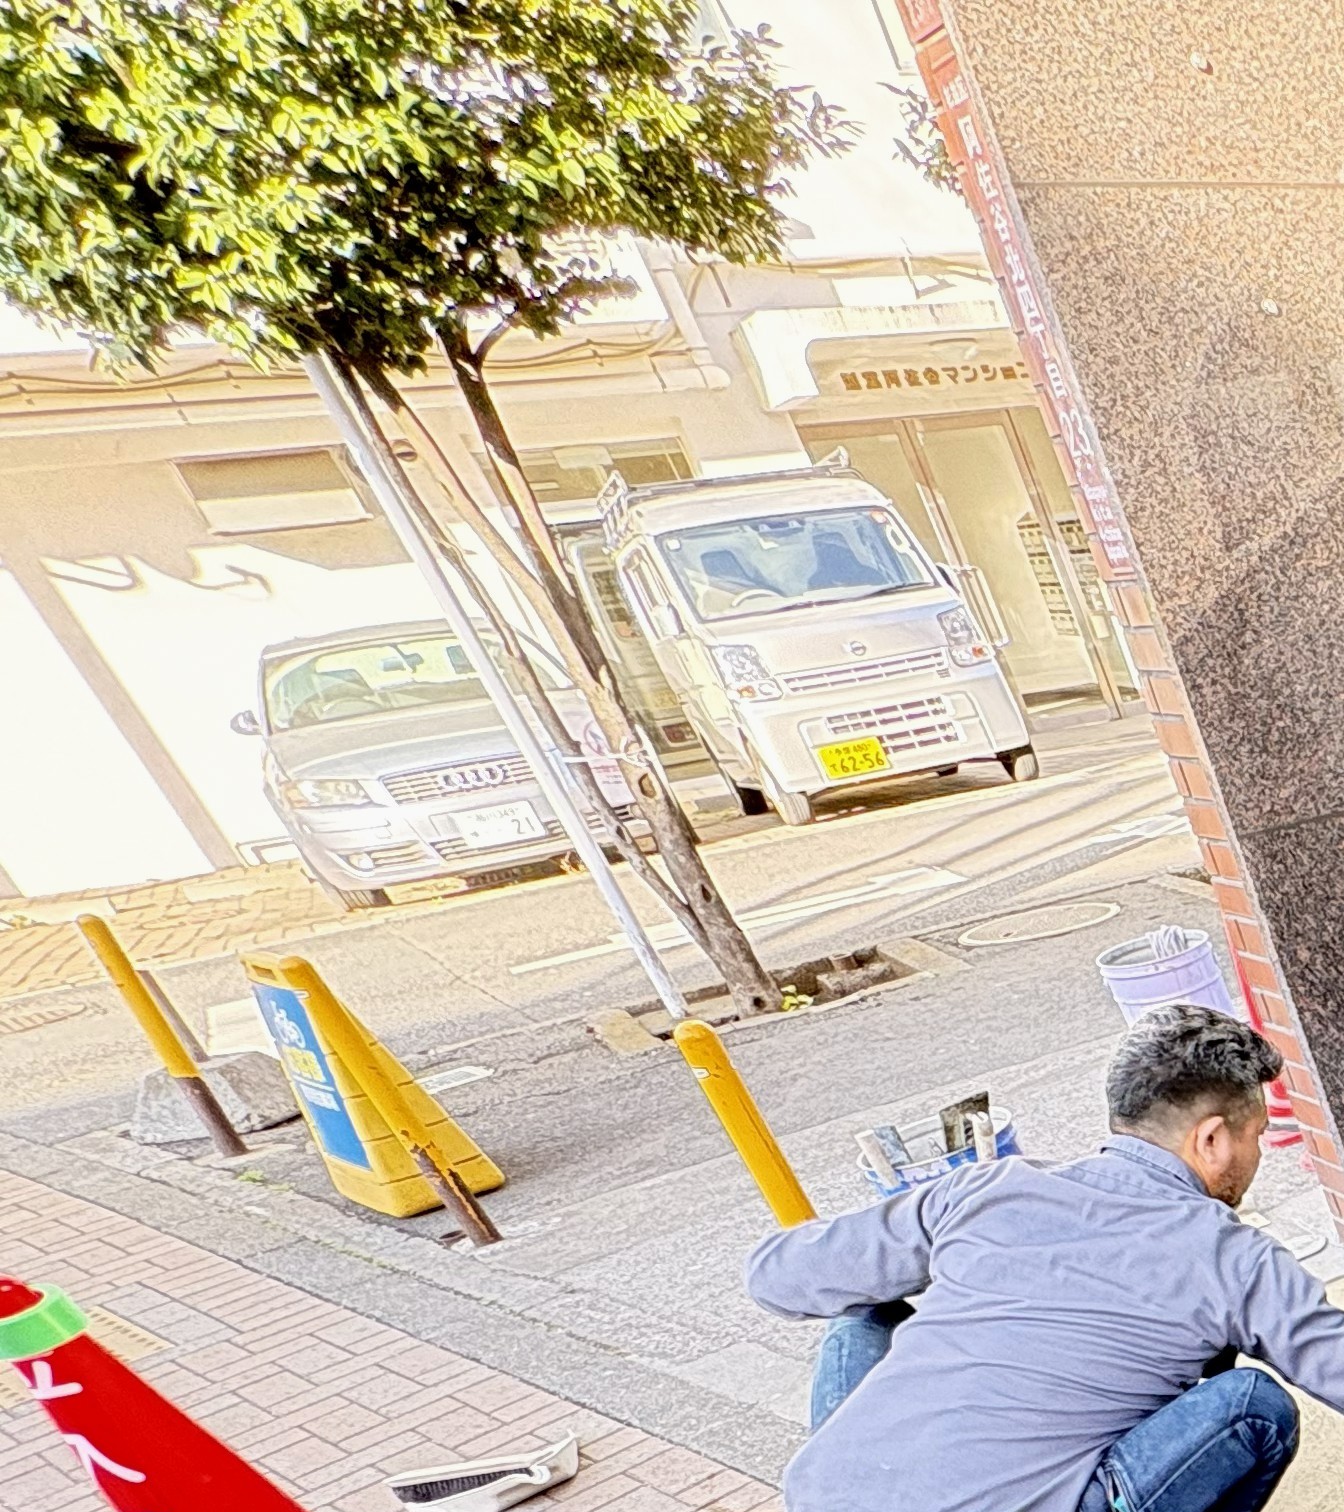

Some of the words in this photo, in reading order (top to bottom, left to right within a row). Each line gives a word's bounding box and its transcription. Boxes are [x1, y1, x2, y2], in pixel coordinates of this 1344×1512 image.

[957, 115, 1067, 398] 阿佐谷北四丁目
[840, 752, 885, 773] 62-56
